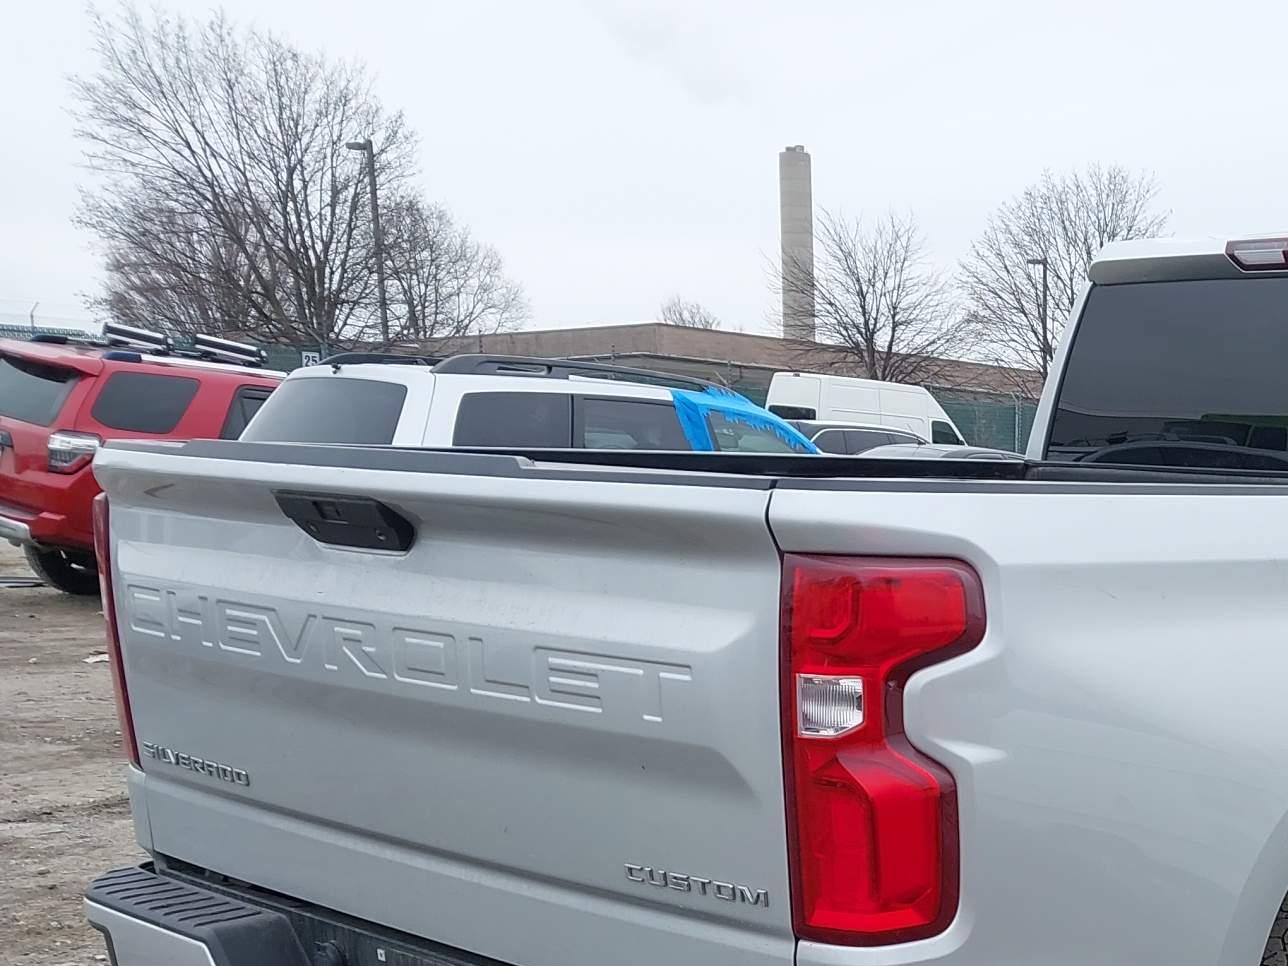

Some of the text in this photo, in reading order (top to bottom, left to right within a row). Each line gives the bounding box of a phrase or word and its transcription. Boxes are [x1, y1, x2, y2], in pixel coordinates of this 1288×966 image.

[125, 583, 693, 722] CHEVROLET
[143, 741, 250, 787] SILVERADO
[624, 863, 769, 908] CUSTOM
